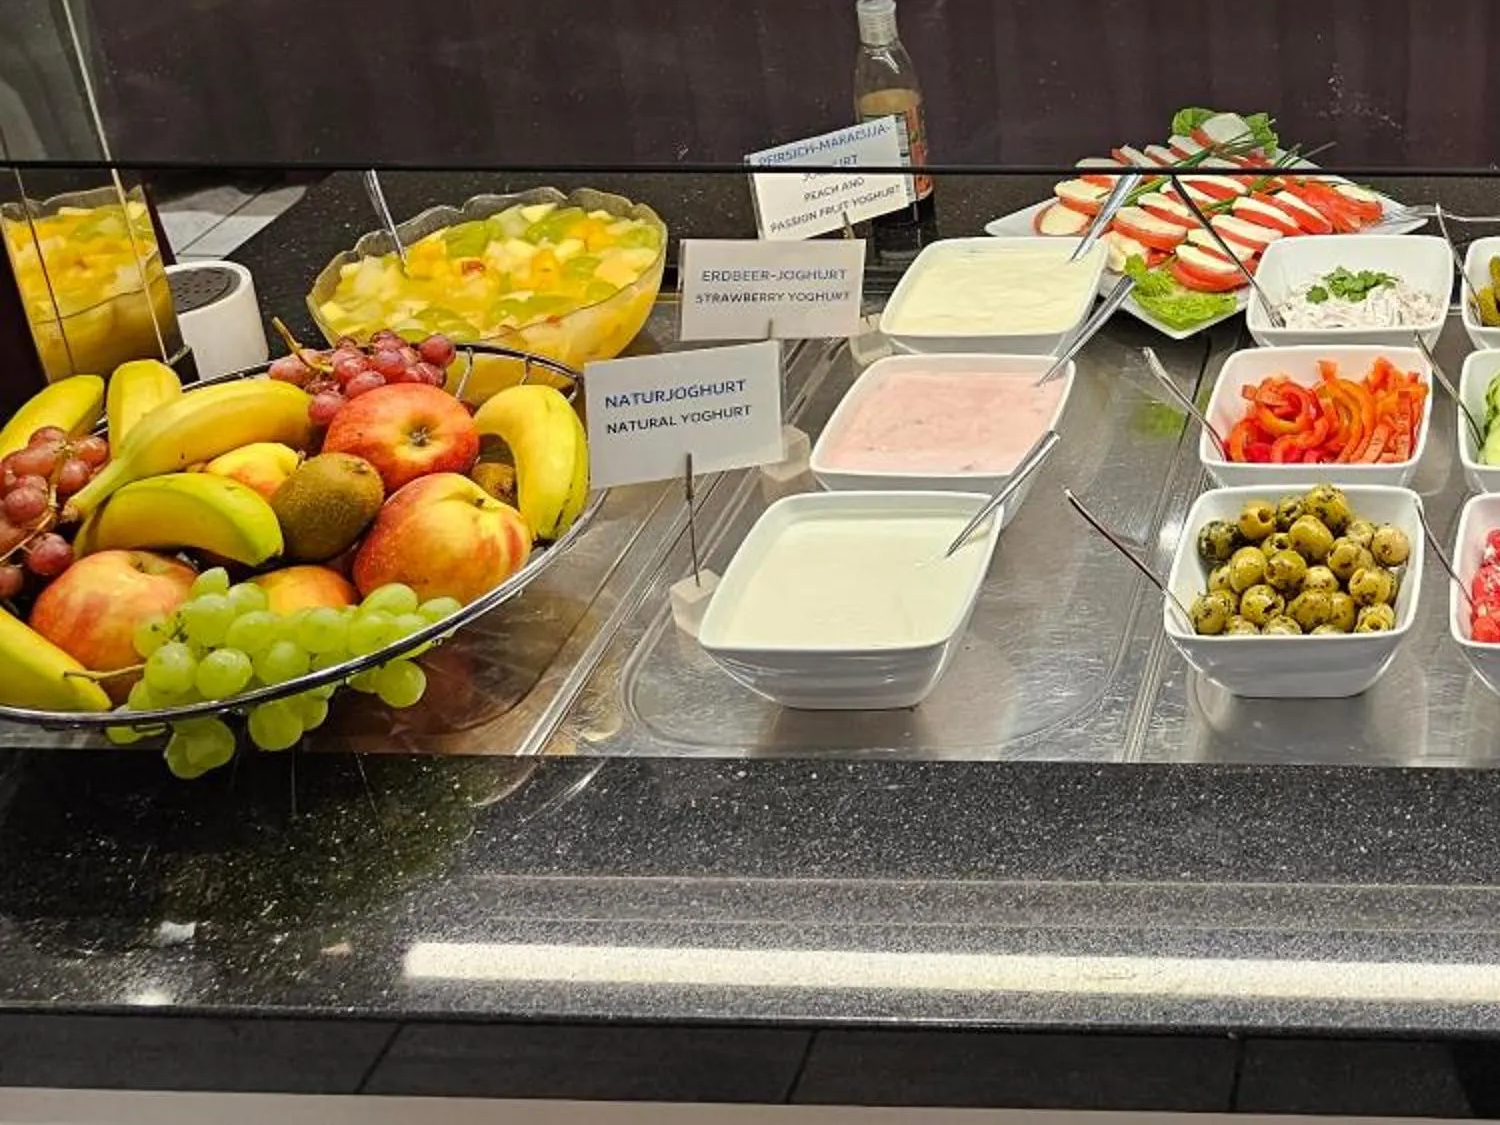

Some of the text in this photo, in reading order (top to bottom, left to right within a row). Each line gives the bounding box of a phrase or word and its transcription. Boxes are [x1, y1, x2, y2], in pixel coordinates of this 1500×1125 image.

[803, 177, 865, 203] PEACH AND
[770, 184, 901, 233] PASSION FRUIT YOGHURT
[702, 268, 848, 283] ERDBEER-JOGHURT
[695, 290, 850, 304] STRAWBERRY YOGHURT
[605, 379, 747, 409] NATURJOGHURT
[606, 404, 752, 435] NATURAL YOGHURT
